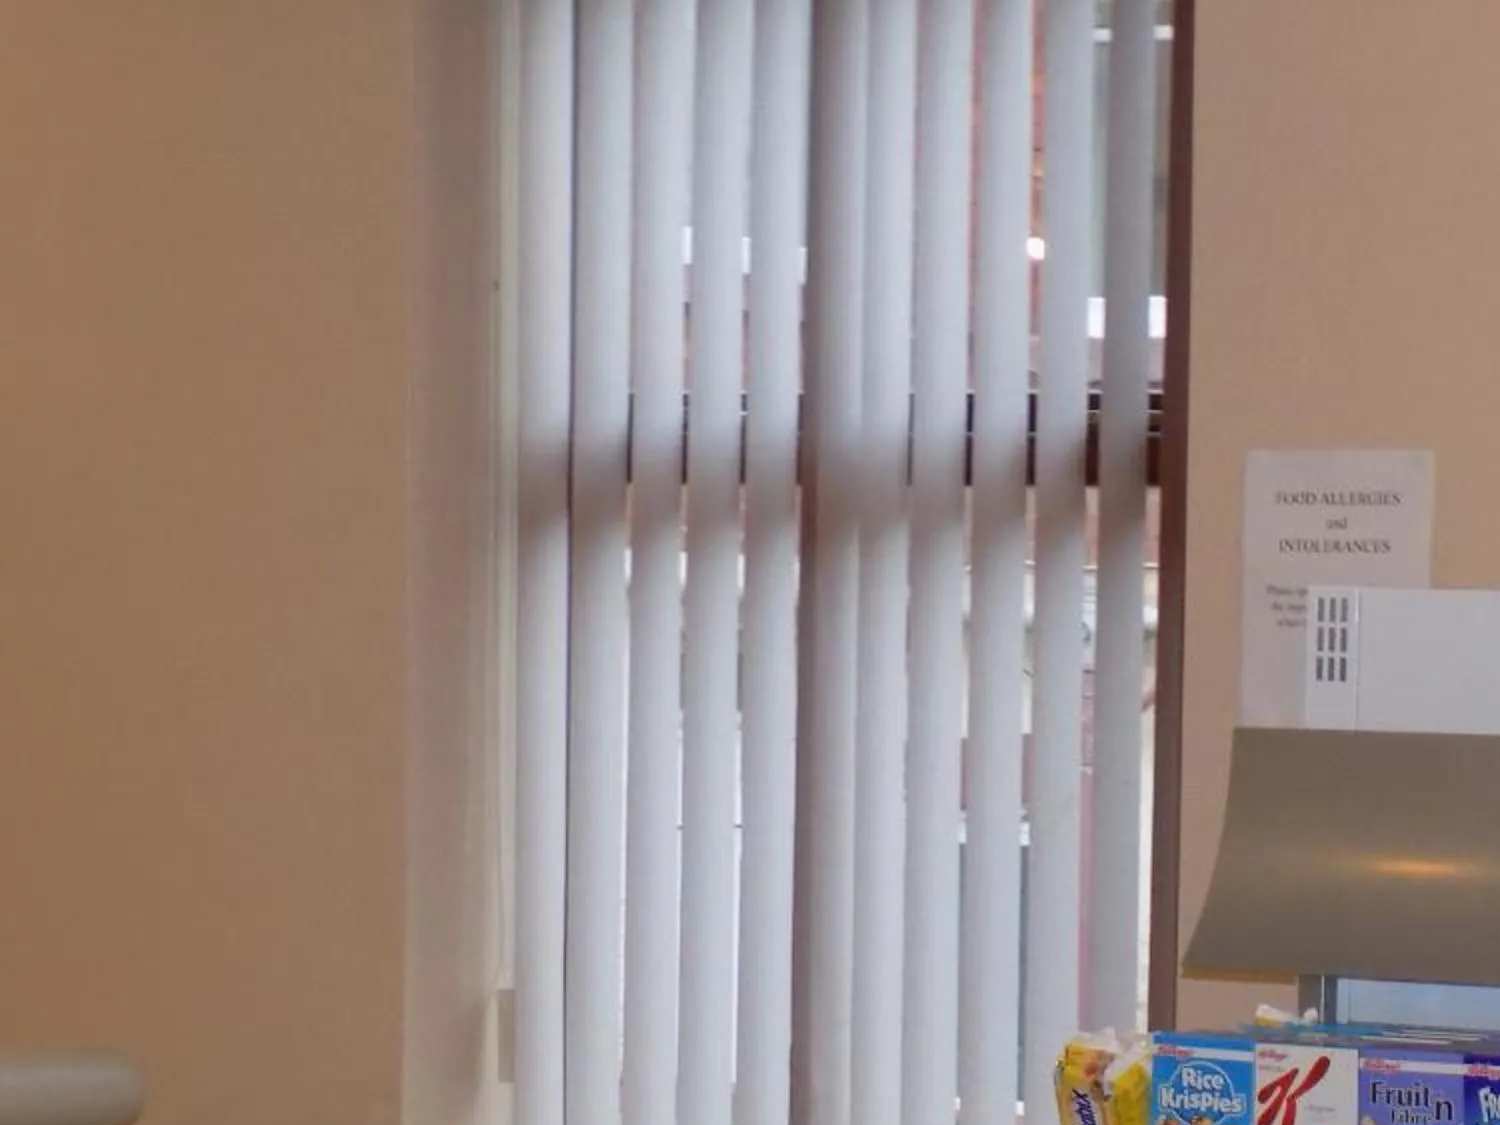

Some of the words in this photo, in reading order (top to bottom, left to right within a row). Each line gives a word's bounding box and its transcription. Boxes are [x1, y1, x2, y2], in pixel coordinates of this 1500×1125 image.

[1275, 491, 1317, 506] FOOD
[1320, 491, 1402, 506] ALLERGIES
[1326, 516, 1348, 530] and
[1279, 538, 1392, 554] INTOLERANCES
[1181, 1065, 1225, 1091] Rice
[1159, 1084, 1246, 1116] Krispies
[1371, 1081, 1430, 1107] Fruit
